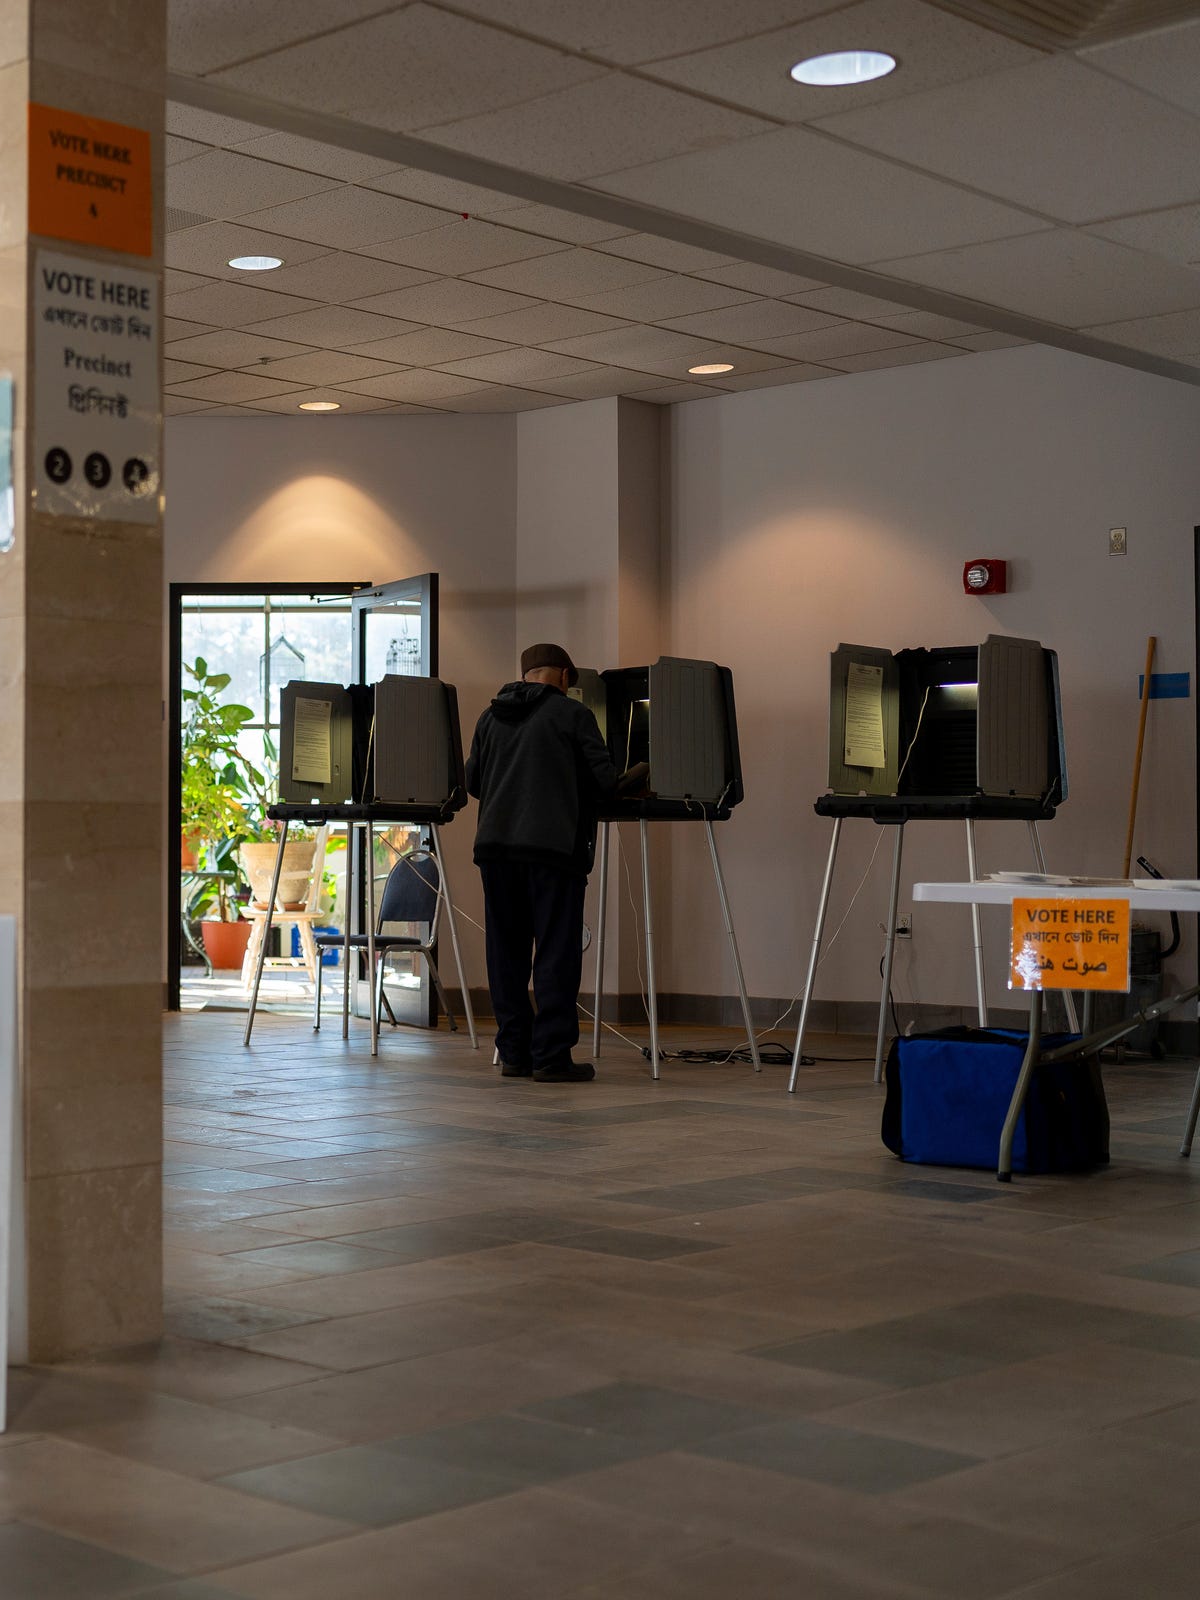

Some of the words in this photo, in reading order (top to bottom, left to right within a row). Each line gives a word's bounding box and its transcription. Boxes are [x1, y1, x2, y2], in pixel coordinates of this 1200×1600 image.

[48, 129, 89, 155] VOTE
[56, 163, 127, 195] PRECINCT
[43, 268, 96, 300] VOTE
[101, 281, 151, 311] HERE
[63, 347, 132, 379] Precinct
[1026, 909, 1069, 923] VOTE
[1074, 910, 1116, 924] HERE
[1064, 929, 1093, 944] ভোট
[1098, 929, 1120, 944] দিন
[1062, 957, 1108, 976] صوت
